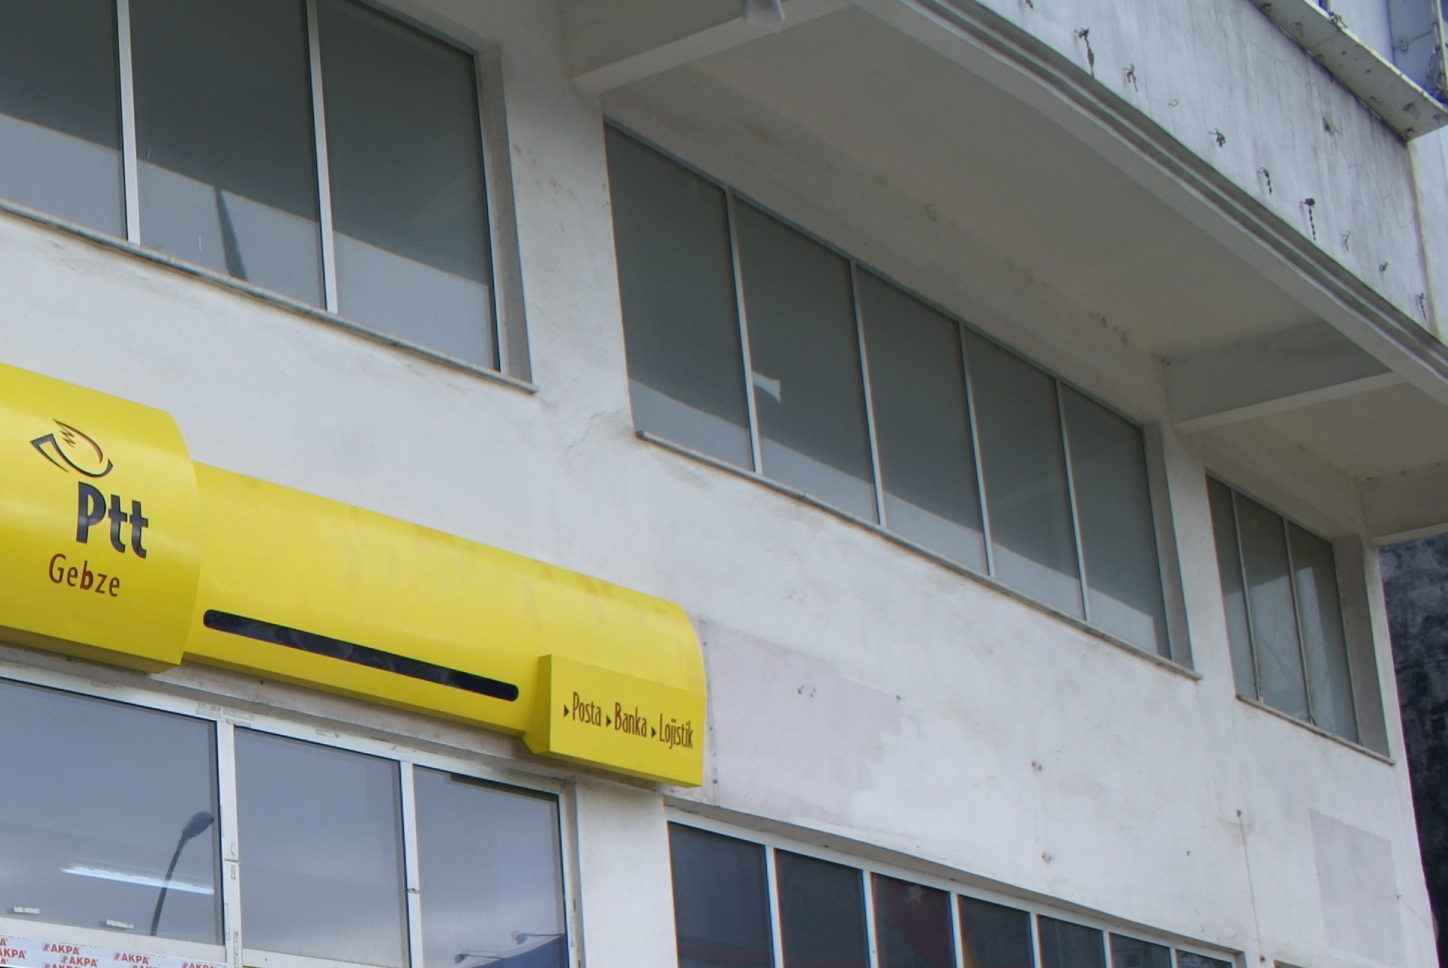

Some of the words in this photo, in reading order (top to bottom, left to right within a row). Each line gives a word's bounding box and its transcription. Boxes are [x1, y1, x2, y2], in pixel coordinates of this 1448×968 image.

[76, 481, 149, 559] Ptt
[48, 553, 120, 597] Gebze
[572, 691, 601, 727] Posta
[614, 702, 647, 738] Banka
[659, 713, 693, 749] Lojistik
[51, 944, 80, 955] AKPA
[69, 957, 98, 967] AKPA
[121, 953, 149, 965] AKPA
